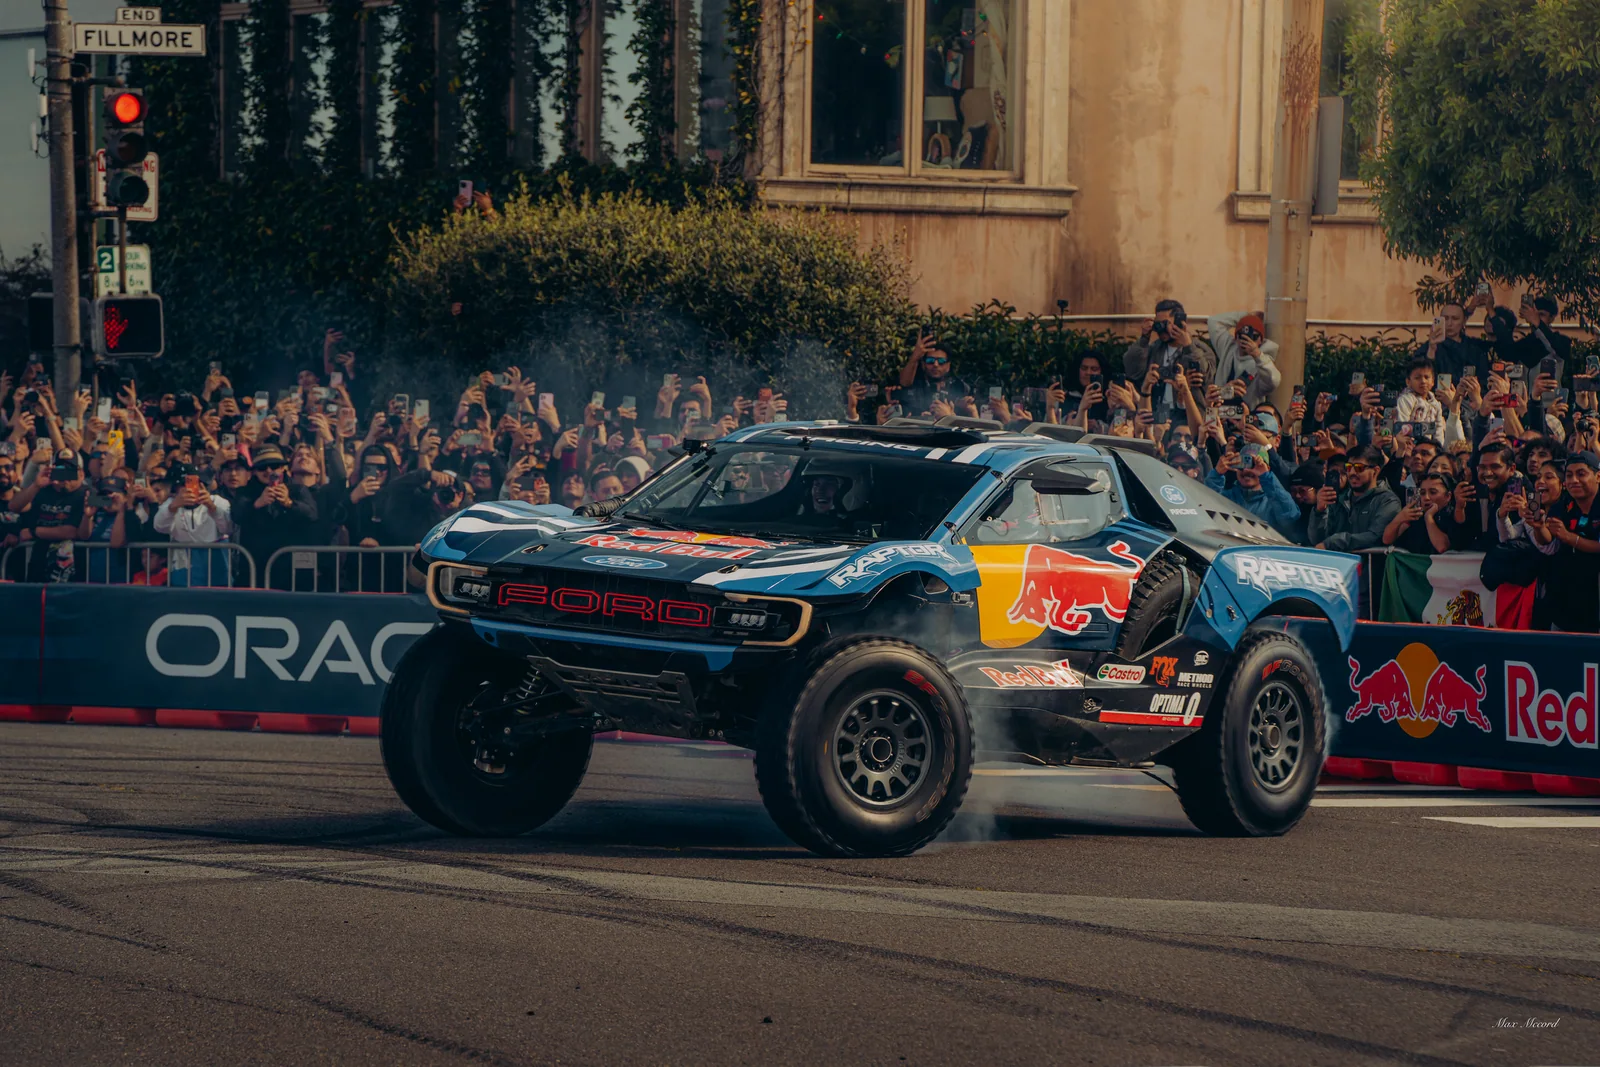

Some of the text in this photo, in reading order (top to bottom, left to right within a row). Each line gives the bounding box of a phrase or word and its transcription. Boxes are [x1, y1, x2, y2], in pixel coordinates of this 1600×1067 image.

[122, 9, 156, 21] END
[84, 30, 193, 48] FILLMORE
[99, 251, 113, 270] 2
[570, 533, 763, 561] Red Bull
[826, 543, 960, 591] RAPTOR
[1233, 553, 1352, 608] RAPTOR
[498, 583, 711, 628] FORD
[978, 664, 1044, 688] Red
[1108, 667, 1144, 681] Castrol
[1149, 655, 1179, 680] FOX
[1178, 671, 1215, 684] METHOD
[1149, 693, 1187, 714] OPTIMA
[1504, 660, 1600, 750] Red
